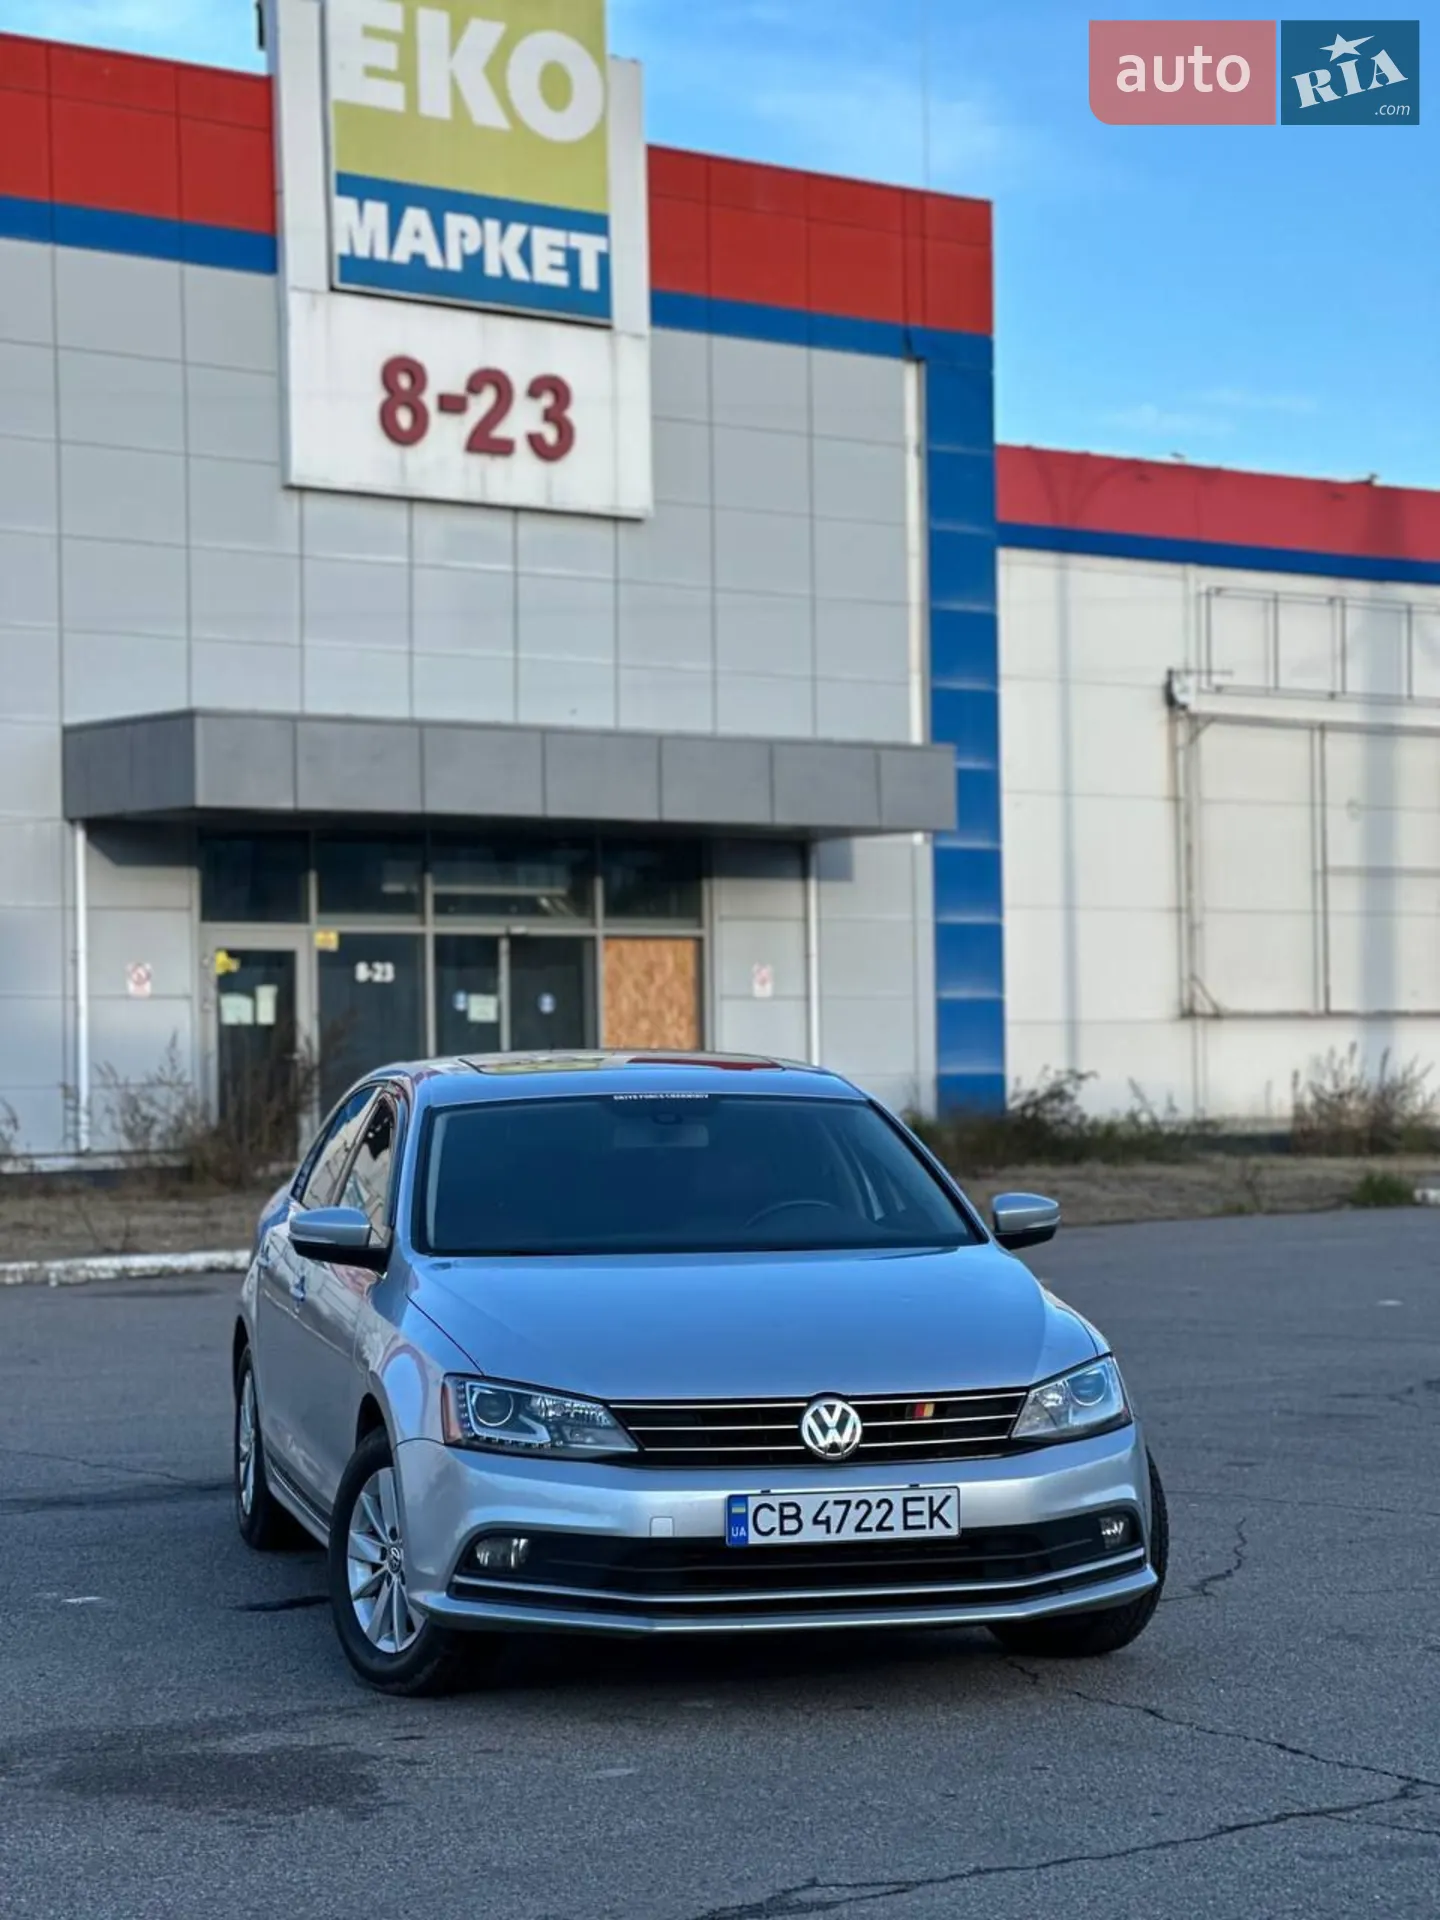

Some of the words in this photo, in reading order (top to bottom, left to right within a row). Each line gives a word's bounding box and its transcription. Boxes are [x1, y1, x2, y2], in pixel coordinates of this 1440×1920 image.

[333, 0, 605, 143] ЕКО
[334, 195, 608, 292] МАРКЕТ
[378, 355, 576, 463] 8-23
[730, 1524, 748, 1538] UA
[752, 1501, 804, 1537] CB
[812, 1499, 895, 1535] 4722
[901, 1494, 952, 1531] EK
